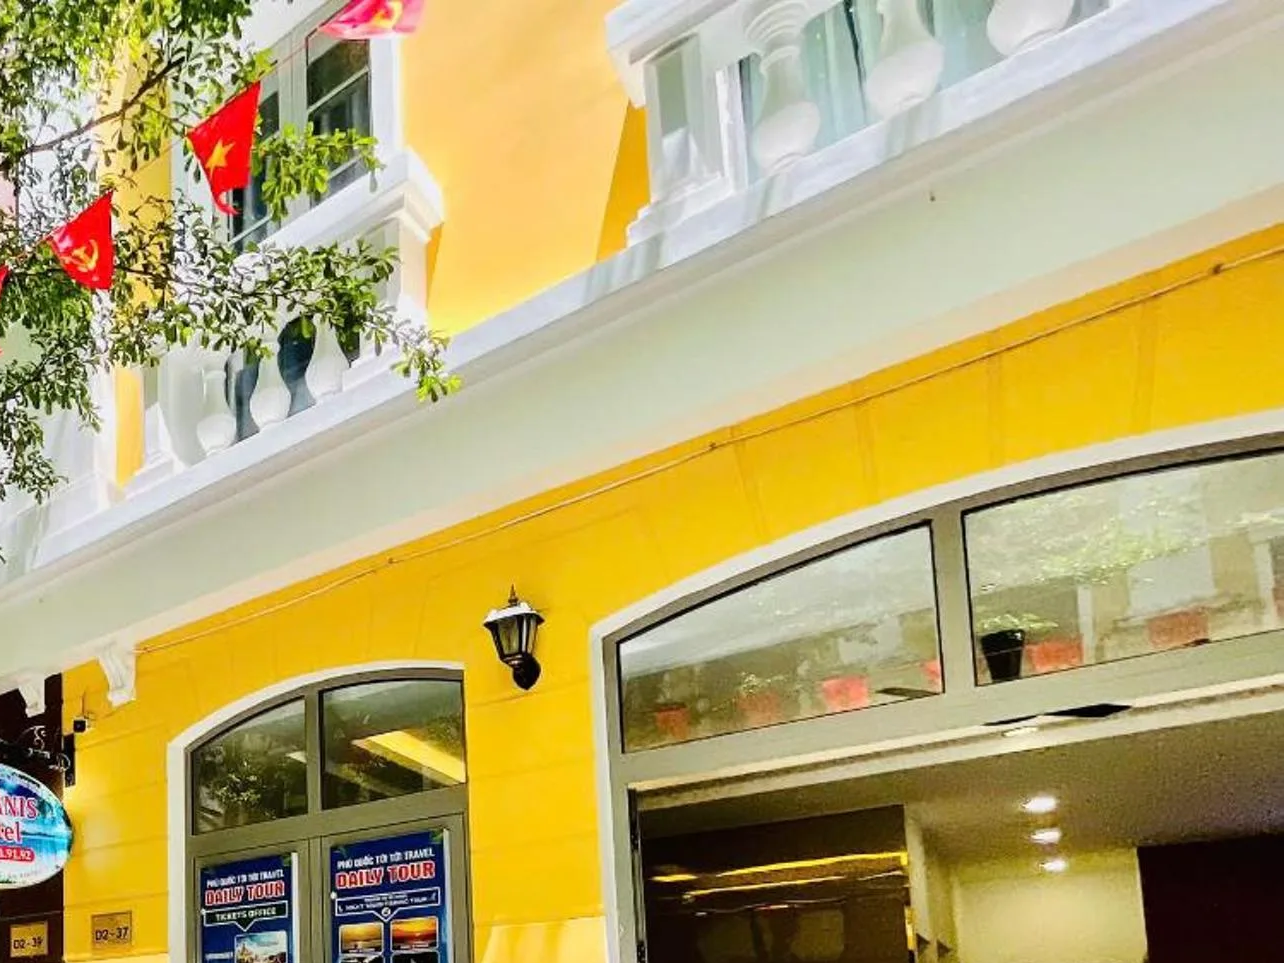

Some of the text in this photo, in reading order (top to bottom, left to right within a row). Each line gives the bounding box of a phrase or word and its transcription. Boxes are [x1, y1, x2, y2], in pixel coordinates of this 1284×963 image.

[404, 847, 436, 861] TRAVEL
[335, 859, 436, 890] DAILY TOUR
[204, 879, 285, 906] DAILY TOUR
[216, 906, 277, 922] TICKETS OFFICE
[95, 926, 129, 941] D2-37
